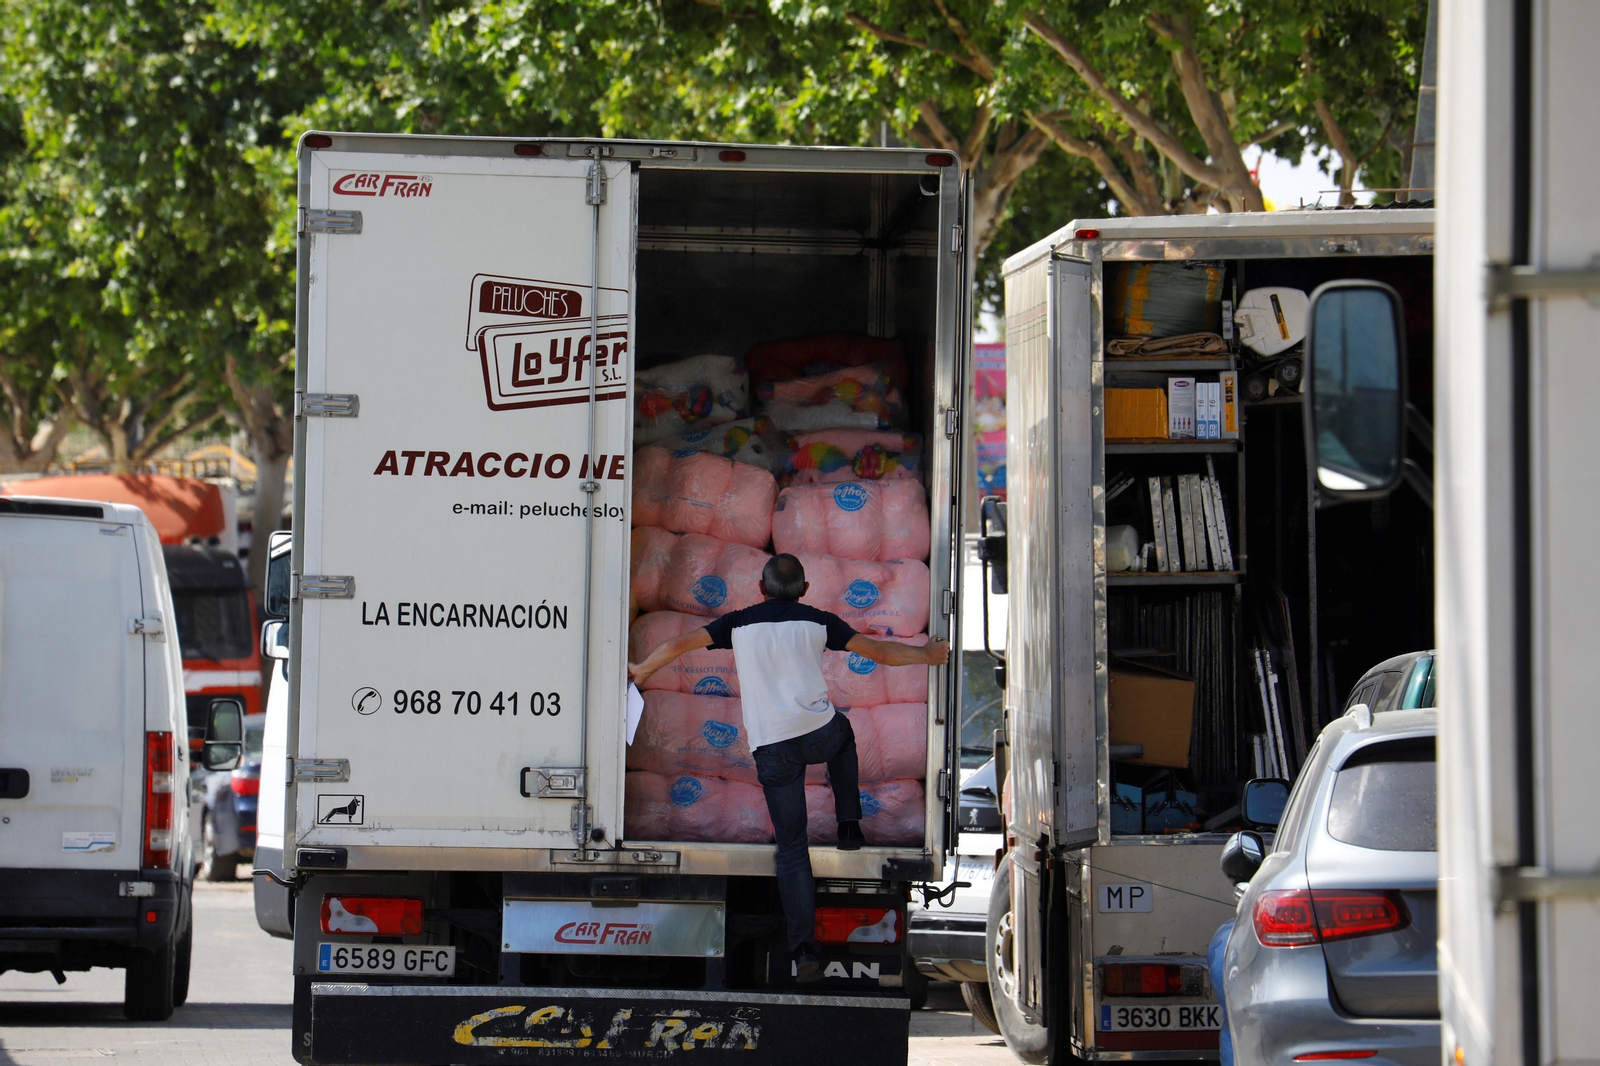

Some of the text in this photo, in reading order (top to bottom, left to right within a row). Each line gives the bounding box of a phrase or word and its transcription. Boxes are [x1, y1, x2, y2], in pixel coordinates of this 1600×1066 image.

[492, 285, 568, 317] PELUCHES
[602, 367, 622, 382] S.L.
[452, 501, 514, 516] e-mail:
[361, 599, 568, 629] LA ENCARNACIÓN
[393, 689, 561, 716] 968 70 41 03
[1107, 886, 1145, 909] MP
[335, 947, 449, 972] 6589 GFC
[1117, 1005, 1220, 1028] 3630 BKK
